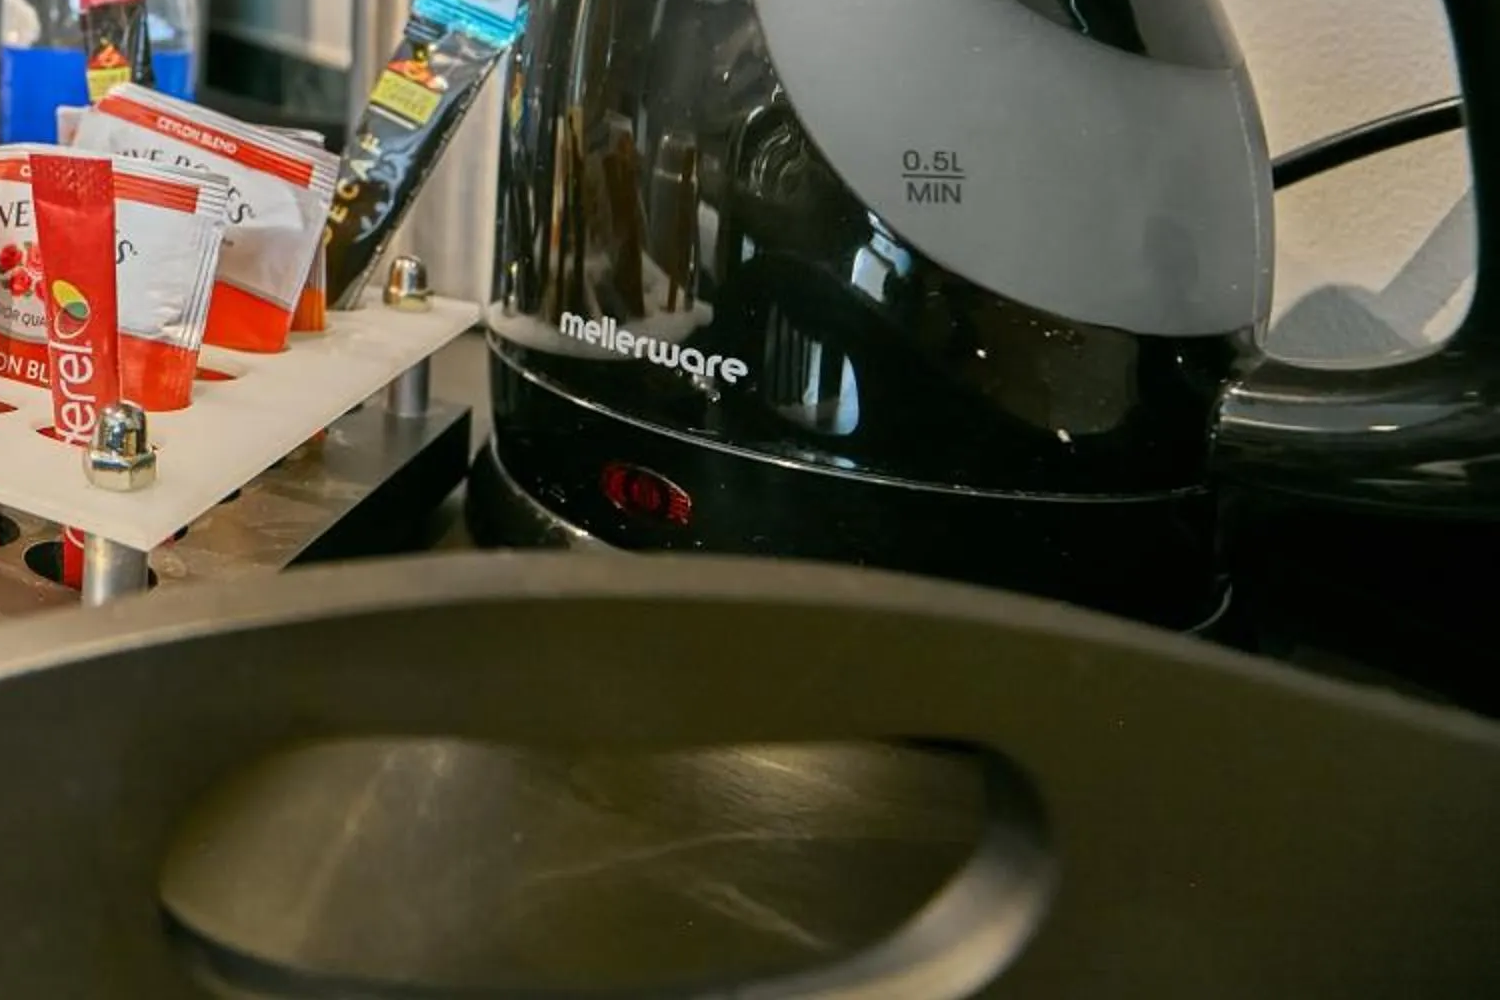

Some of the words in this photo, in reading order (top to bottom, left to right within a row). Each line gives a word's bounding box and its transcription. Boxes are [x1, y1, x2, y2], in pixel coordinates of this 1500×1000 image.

[200, 133, 238, 155] BLEND
[902, 150, 964, 172] 0.5L
[906, 182, 962, 204] MIN
[560, 311, 749, 383] mellerware
